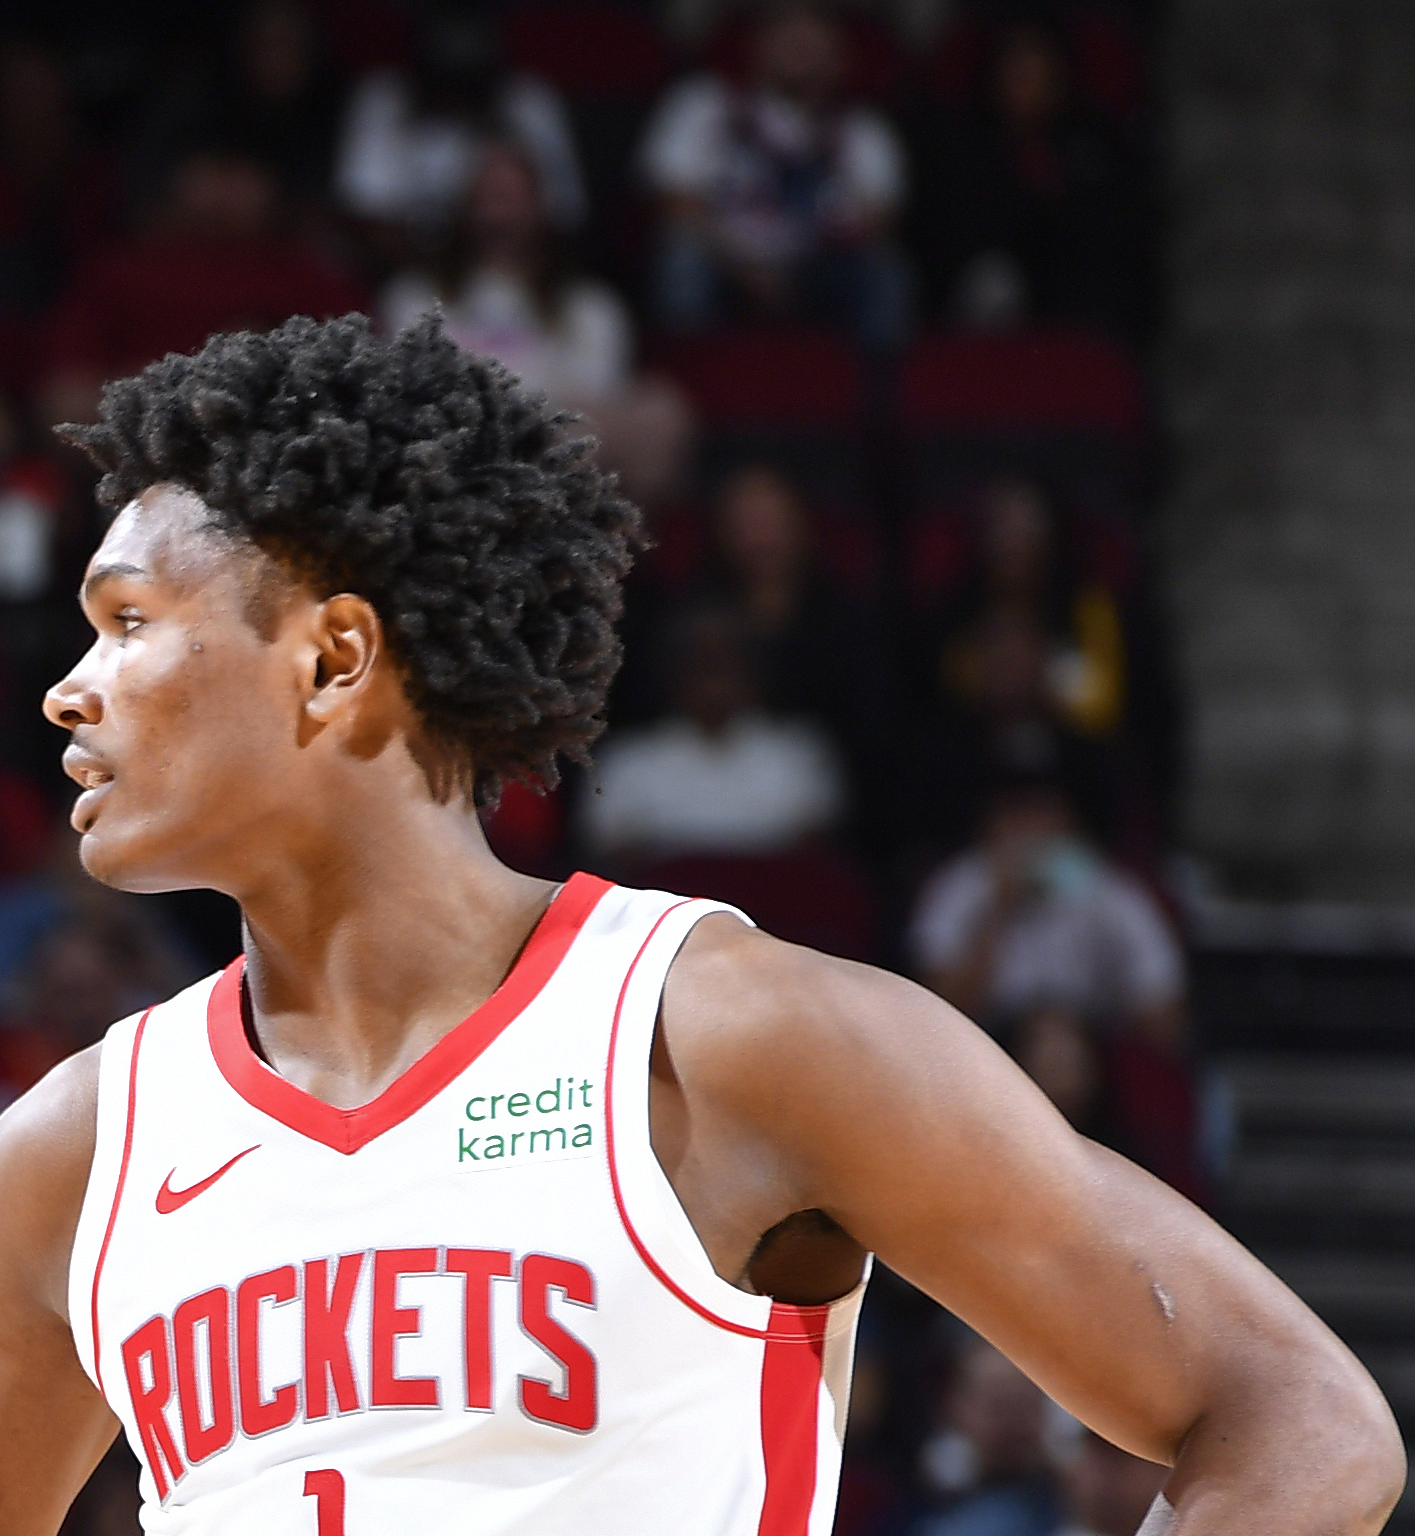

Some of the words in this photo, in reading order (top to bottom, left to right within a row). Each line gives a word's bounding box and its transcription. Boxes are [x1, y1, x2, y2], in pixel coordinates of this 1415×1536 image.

[465, 1077, 594, 1122] credit
[458, 1123, 593, 1163] karma
[120, 1244, 599, 1512] ROCKETS
